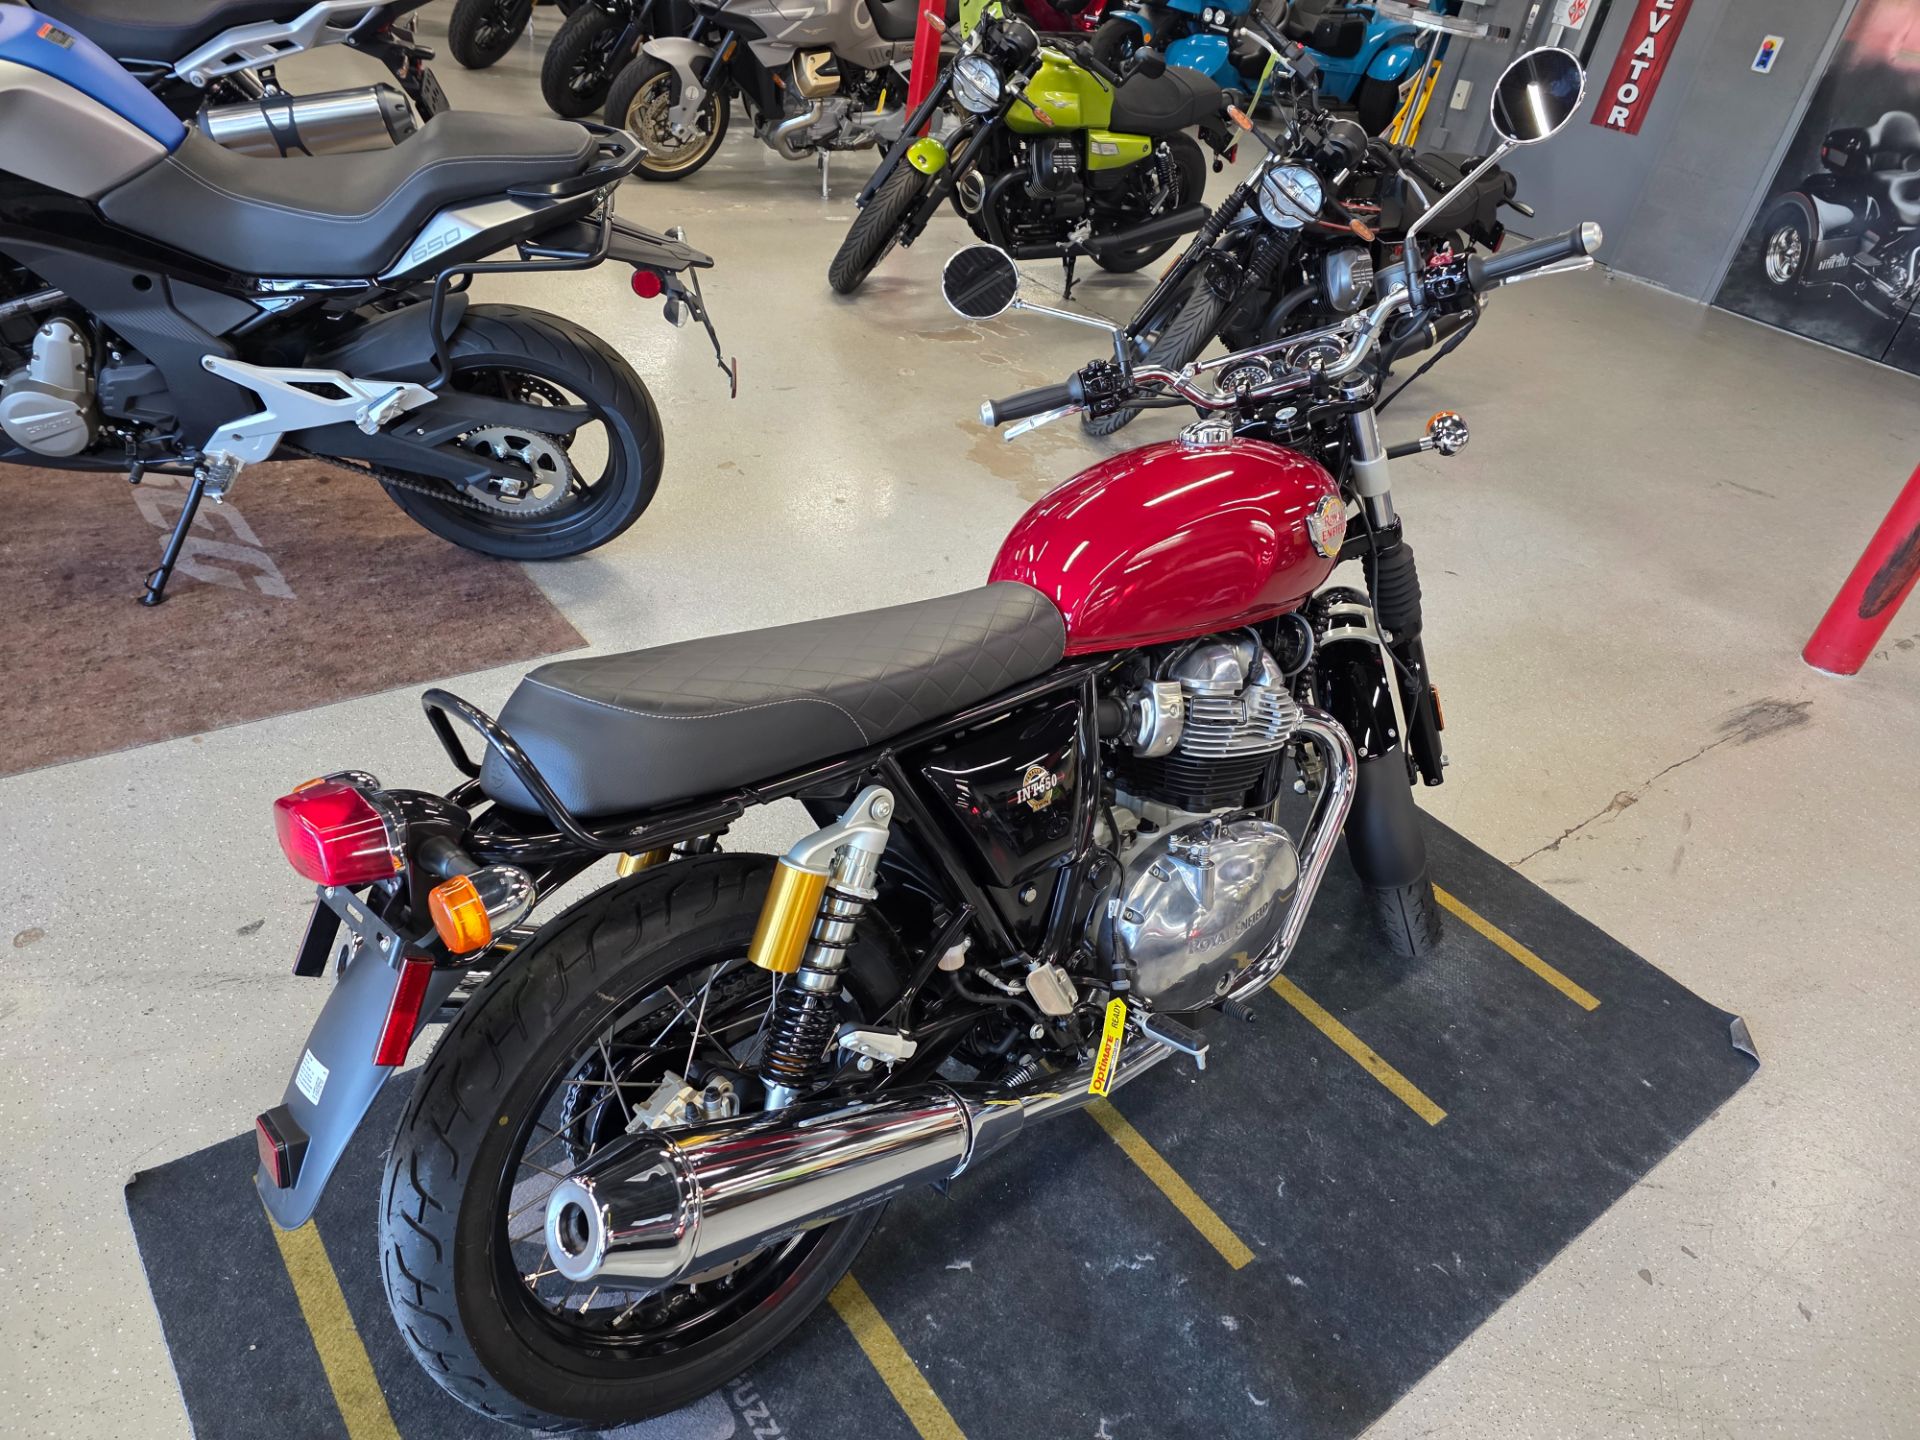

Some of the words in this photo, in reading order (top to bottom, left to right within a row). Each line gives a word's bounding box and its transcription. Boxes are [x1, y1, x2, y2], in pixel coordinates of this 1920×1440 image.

[411, 226, 462, 264] 650
[1016, 773, 1058, 804] INT650
[1110, 1003, 1122, 1029] READY
